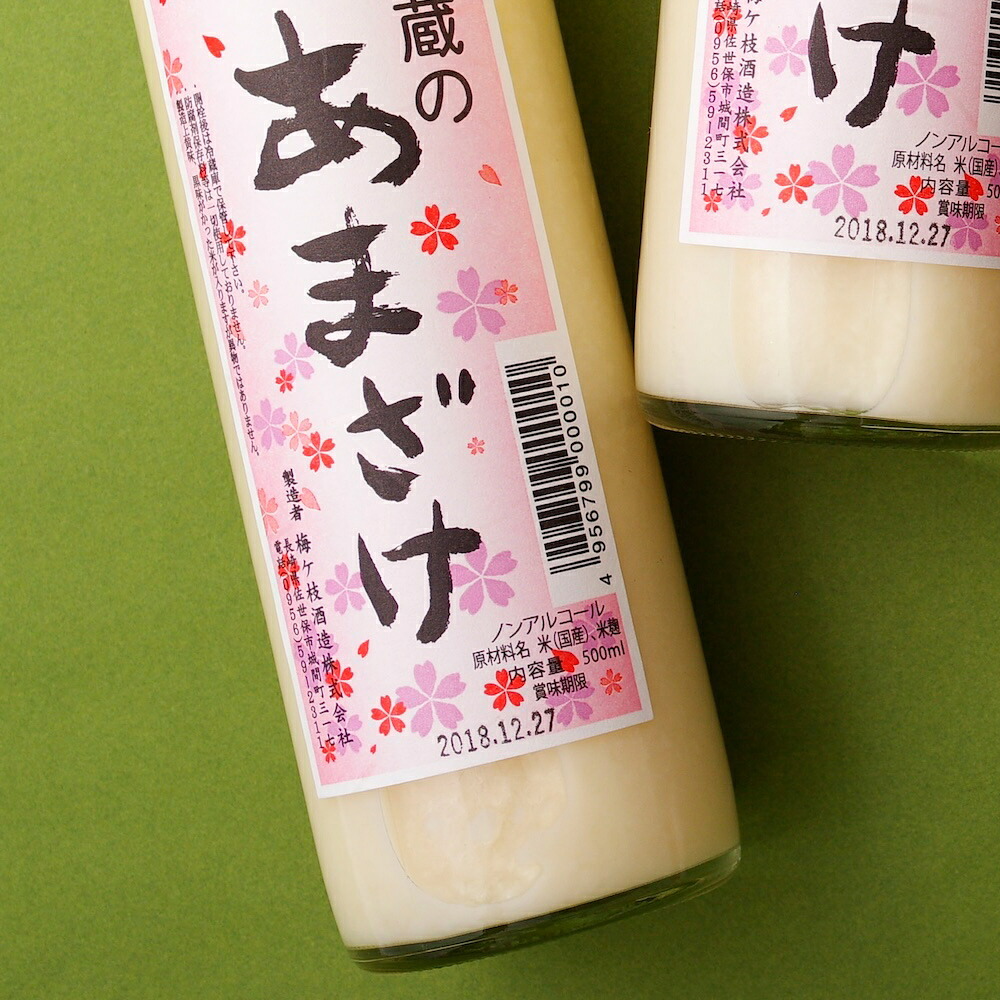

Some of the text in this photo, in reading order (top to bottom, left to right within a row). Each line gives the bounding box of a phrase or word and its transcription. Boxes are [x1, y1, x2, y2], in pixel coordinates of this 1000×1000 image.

[891, 150, 946, 173] 原材料名
[920, 178, 970, 198] 内容量
[937, 199, 985, 220] 賞味期限
[834, 215, 951, 247] 2018.12.27
[234, 10, 483, 644] あまざけ
[552, 364, 613, 586] 4 956799 000010
[282, 468, 304, 522] 製造者
[491, 600, 605, 643] ノンアルコール
[472, 641, 531, 670] 原材料名
[508, 640, 626, 685] 内容量 500ml
[533, 672, 589, 701] 賞味期限
[437, 707, 555, 757] 2018.12.27
